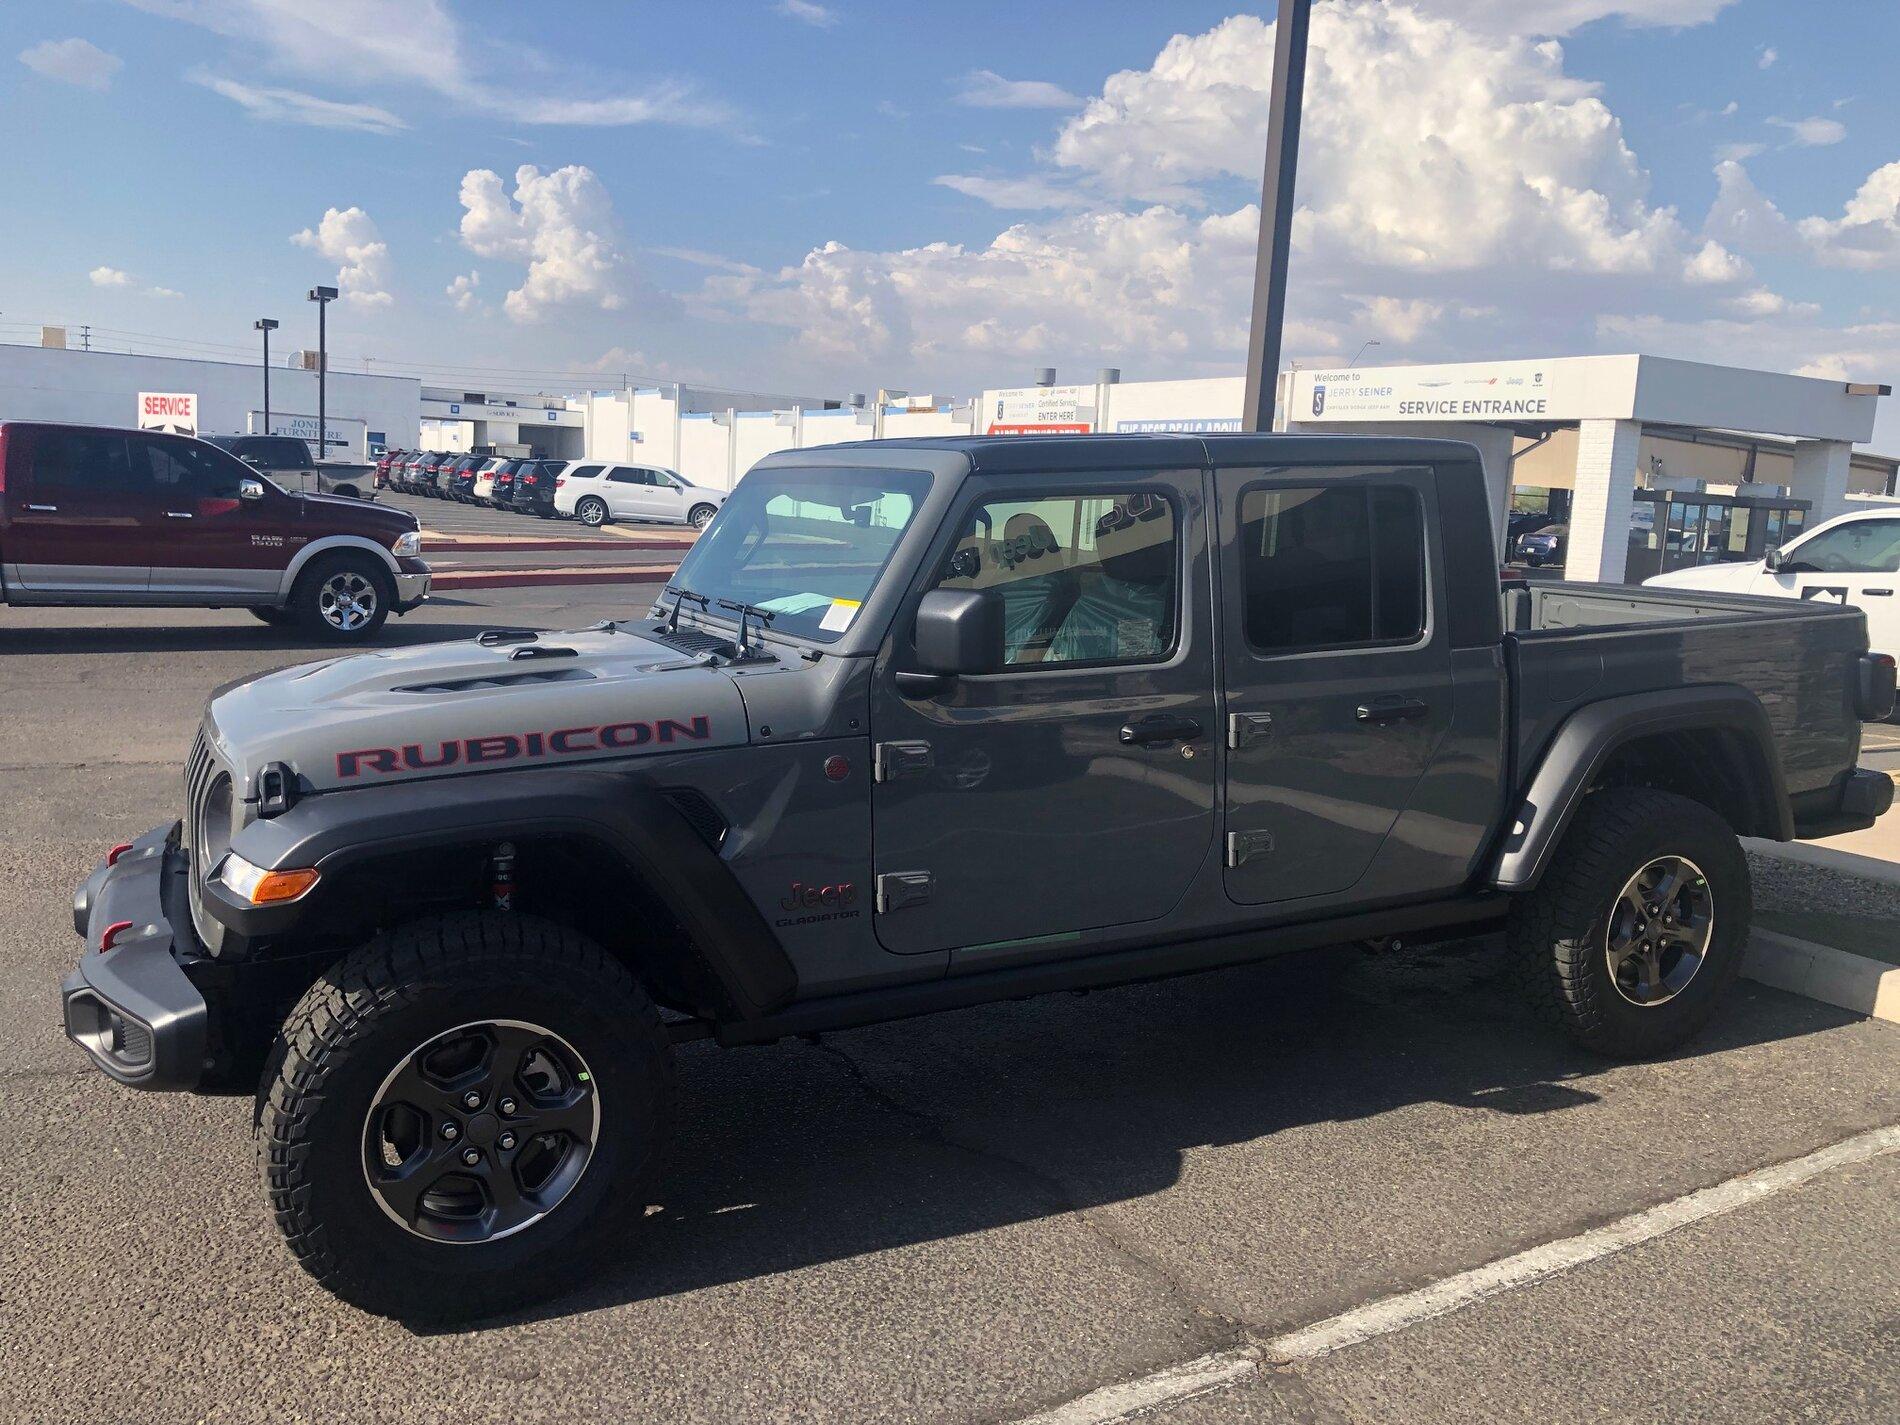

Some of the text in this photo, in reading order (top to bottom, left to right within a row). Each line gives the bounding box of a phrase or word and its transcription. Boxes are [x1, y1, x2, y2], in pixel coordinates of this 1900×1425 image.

[1314, 372, 1360, 382] Welcome to
[1328, 386, 1393, 398] JERRY SEINER
[145, 396, 190, 416] SERVICE
[1038, 399, 1059, 408] Certified
[1398, 399, 1547, 415] SERVICE ENTRANCE
[1038, 411, 1057, 421] ENTER
[1058, 411, 1074, 420] HERE
[276, 427, 343, 440] FURNITRE
[336, 715, 711, 778] RUBICON
[781, 882, 857, 911] Jeep
[775, 910, 860, 927] GLADIATOR
